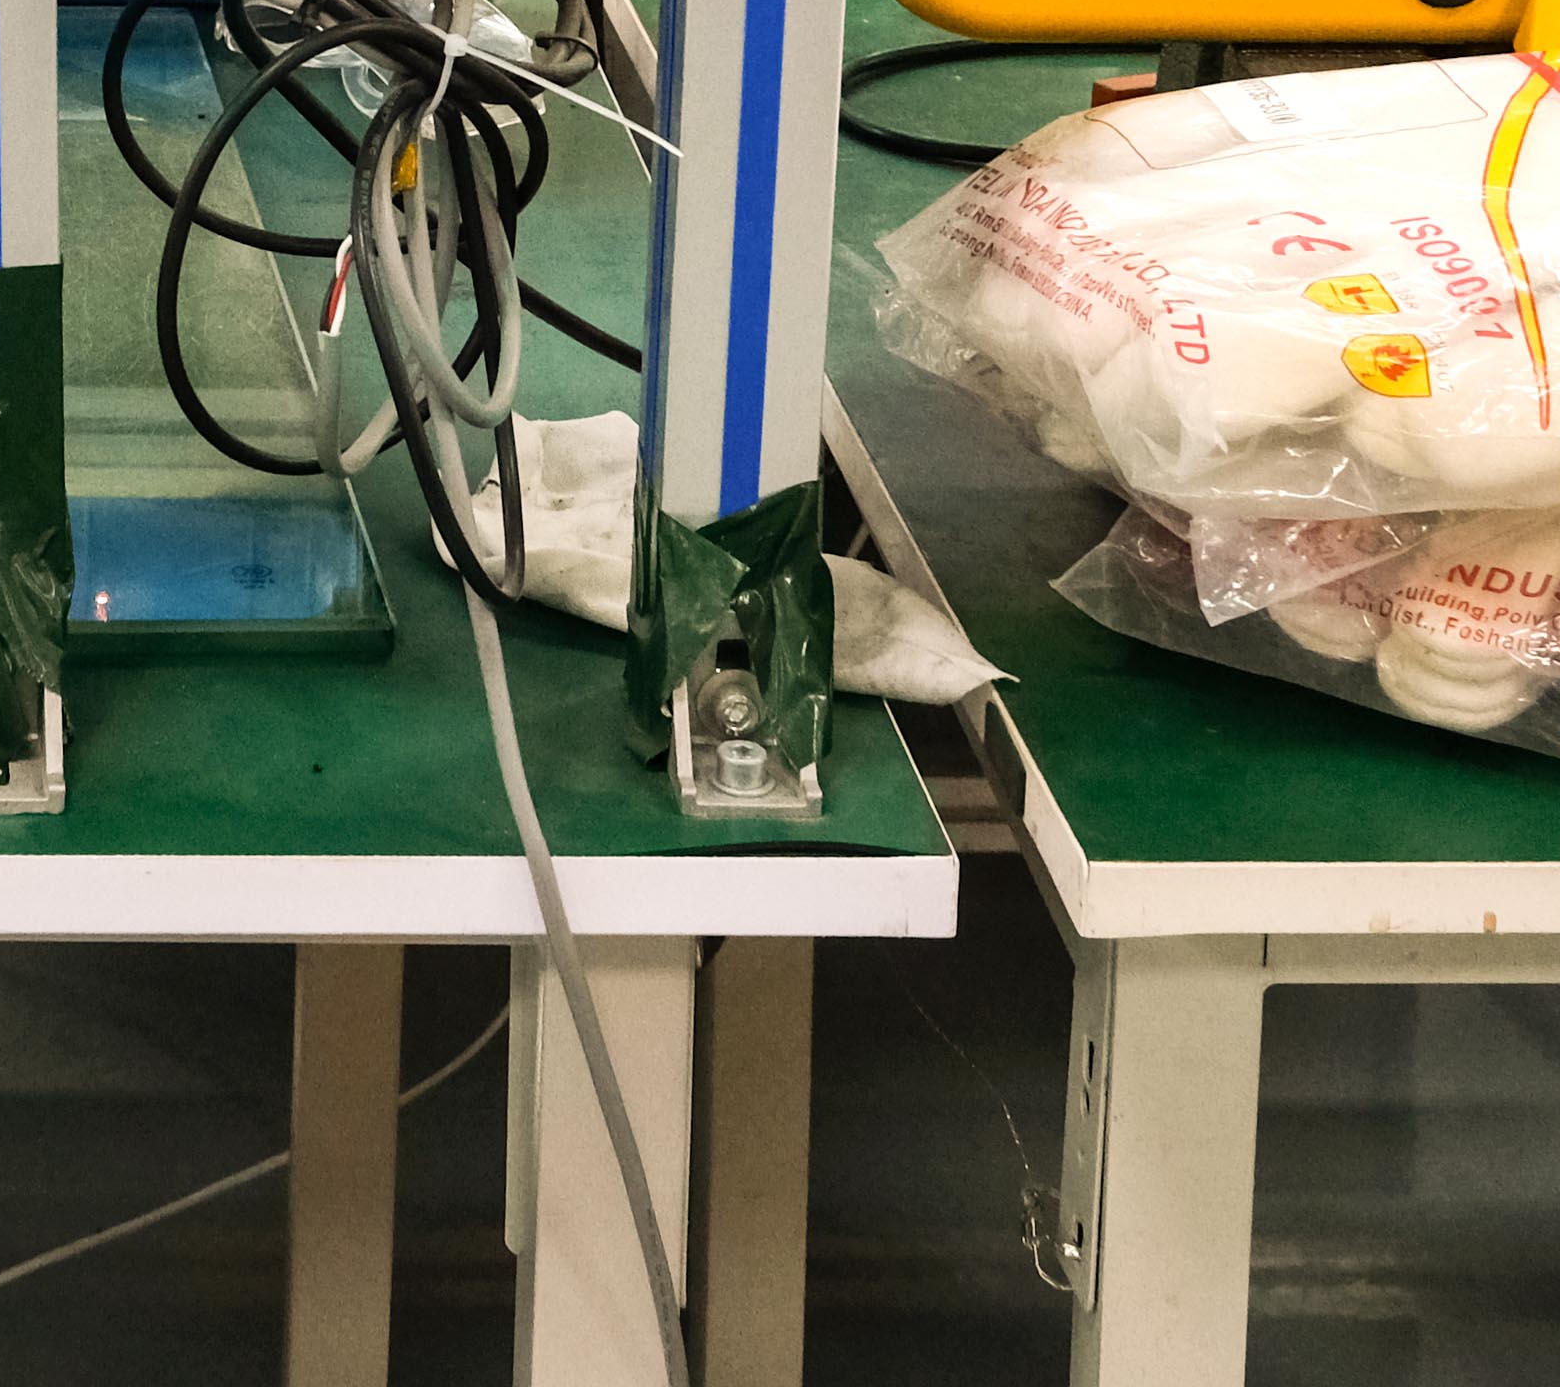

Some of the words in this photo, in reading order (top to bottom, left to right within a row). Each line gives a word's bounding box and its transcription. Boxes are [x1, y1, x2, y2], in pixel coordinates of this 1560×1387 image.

[1389, 216, 1515, 340] ISO9001
[1161, 297, 1211, 366] LTD
[1394, 582, 1490, 622] uilding,
